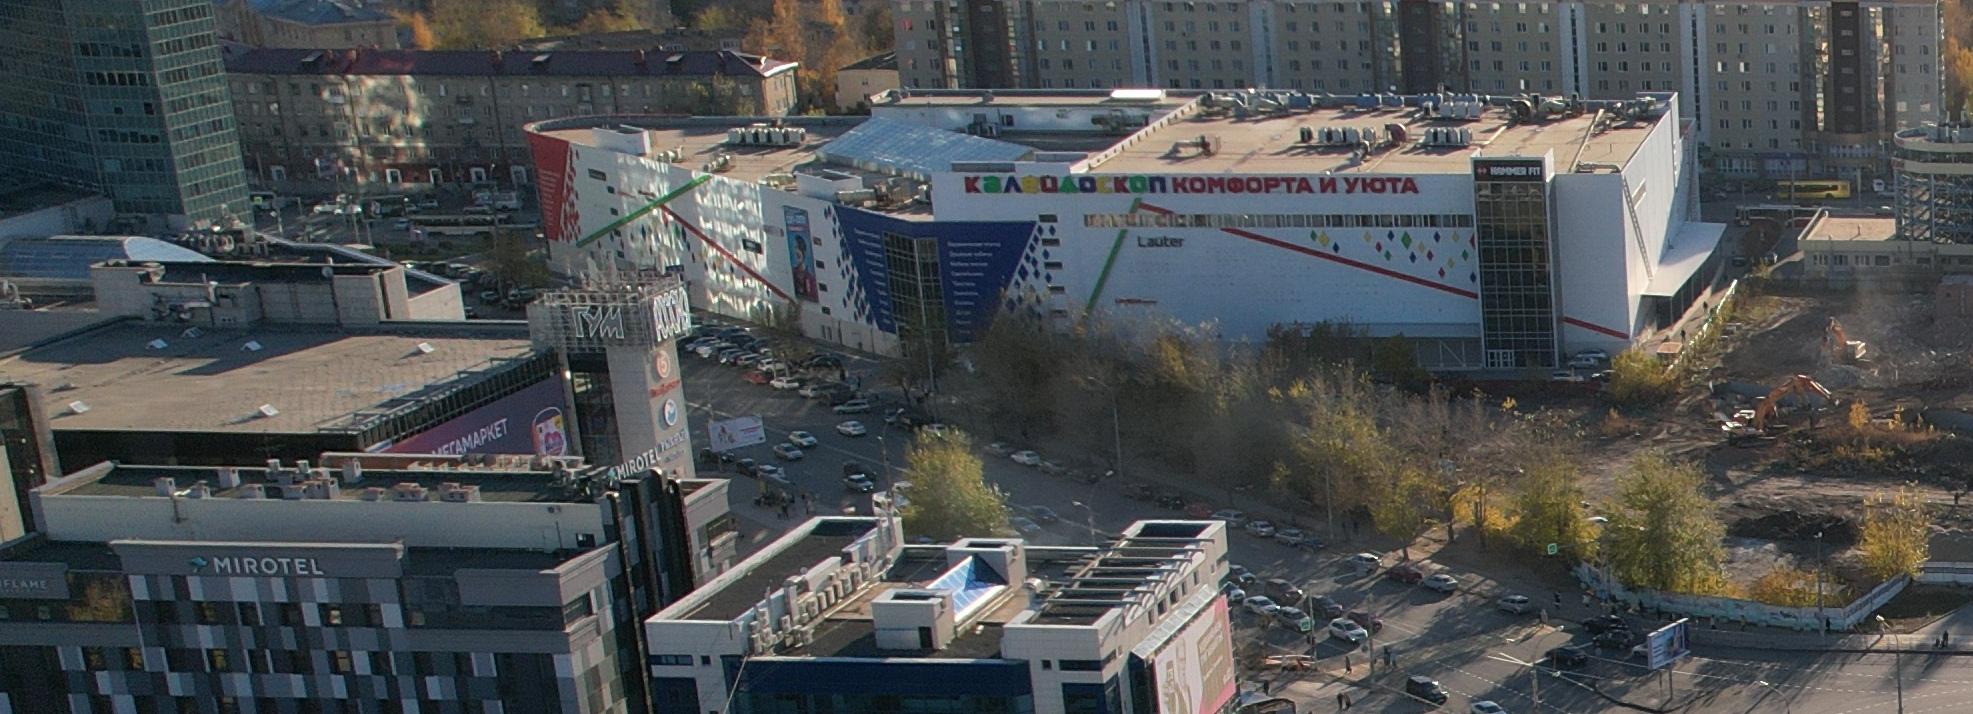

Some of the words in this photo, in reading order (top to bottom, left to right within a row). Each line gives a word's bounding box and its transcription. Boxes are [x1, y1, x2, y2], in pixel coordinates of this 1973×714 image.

[1172, 177, 1313, 194] КОМФОРТА
[1319, 177, 1337, 194] И
[1344, 177, 1420, 194] УЮТА
[1137, 235, 1184, 248] Lauter
[572, 305, 625, 339] ГУМ
[615, 447, 662, 480] MIROTEL
[213, 557, 324, 576] MIROTEL
